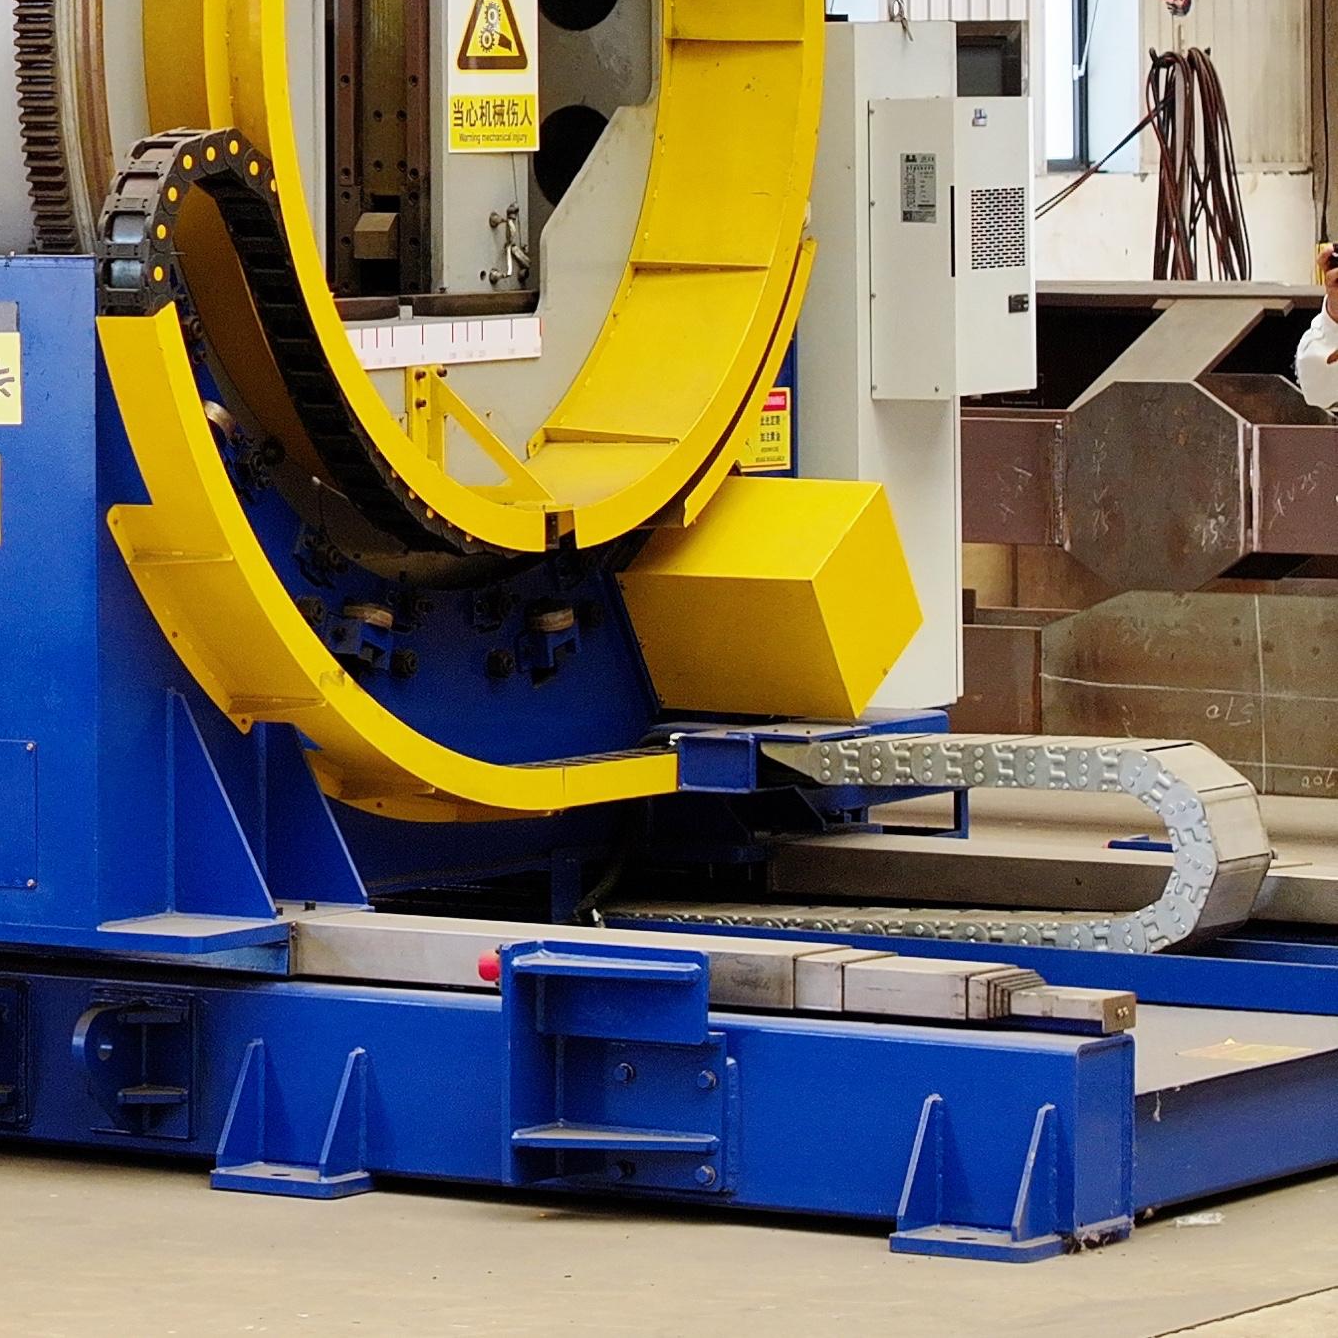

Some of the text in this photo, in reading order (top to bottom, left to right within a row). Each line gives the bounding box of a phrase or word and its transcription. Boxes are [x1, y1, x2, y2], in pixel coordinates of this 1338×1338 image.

[453, 99, 532, 128] 当心机械伤人
[460, 133, 480, 144] Warning
[482, 133, 511, 142] mechanical
